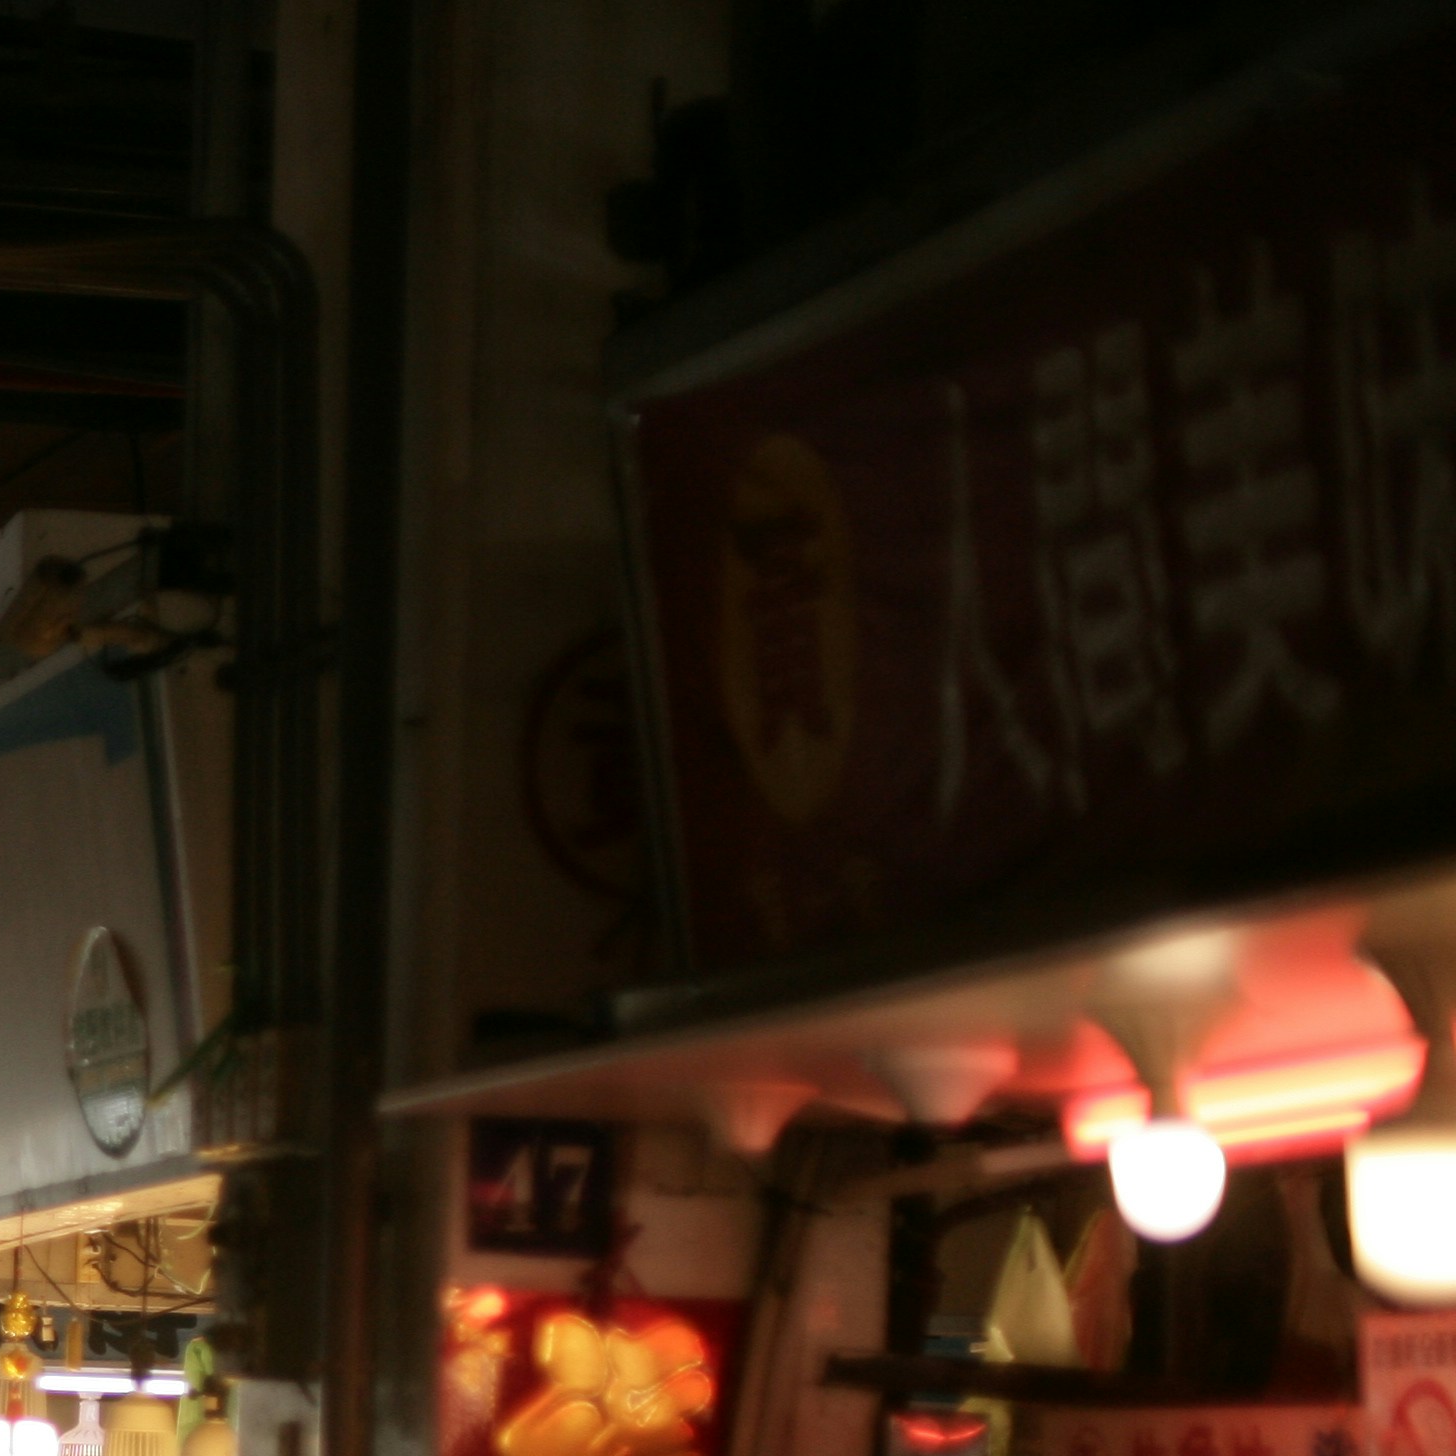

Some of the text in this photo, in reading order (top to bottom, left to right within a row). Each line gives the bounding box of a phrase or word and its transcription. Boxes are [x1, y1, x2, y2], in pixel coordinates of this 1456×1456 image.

[936, 160, 1456, 828] 人間美味
[502, 1143, 597, 1236] 17
